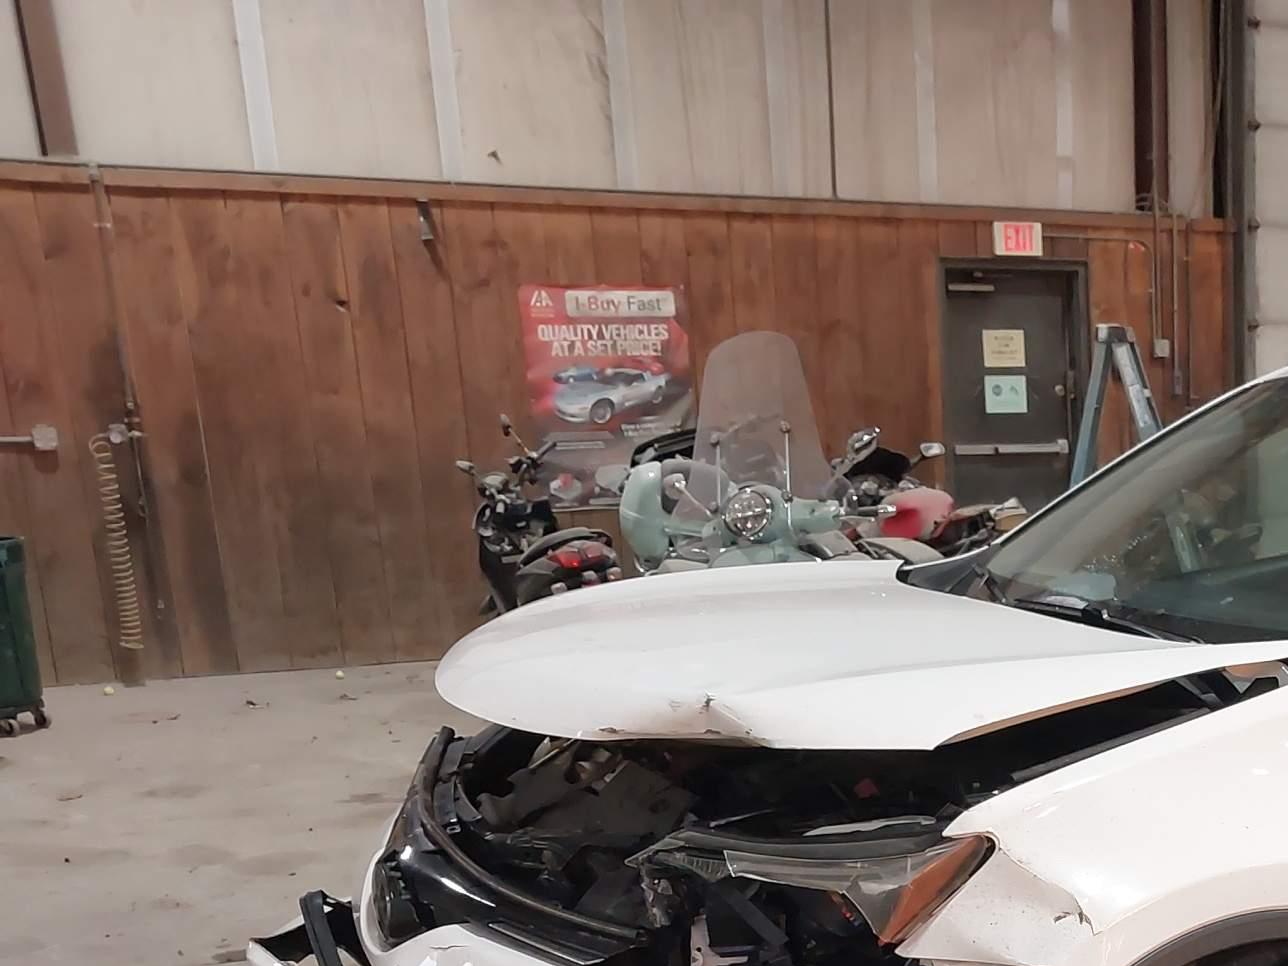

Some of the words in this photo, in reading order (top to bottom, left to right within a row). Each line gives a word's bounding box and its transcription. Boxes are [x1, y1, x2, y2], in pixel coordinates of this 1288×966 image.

[1004, 223, 1034, 252] EXIT
[575, 295, 621, 314] I-Buy
[537, 323, 600, 341] QUALITY
[601, 323, 669, 341] VEHICLES
[551, 341, 572, 357] AT
[573, 341, 585, 357] A
[587, 341, 614, 357] SET
[616, 340, 662, 356] PRICE!
